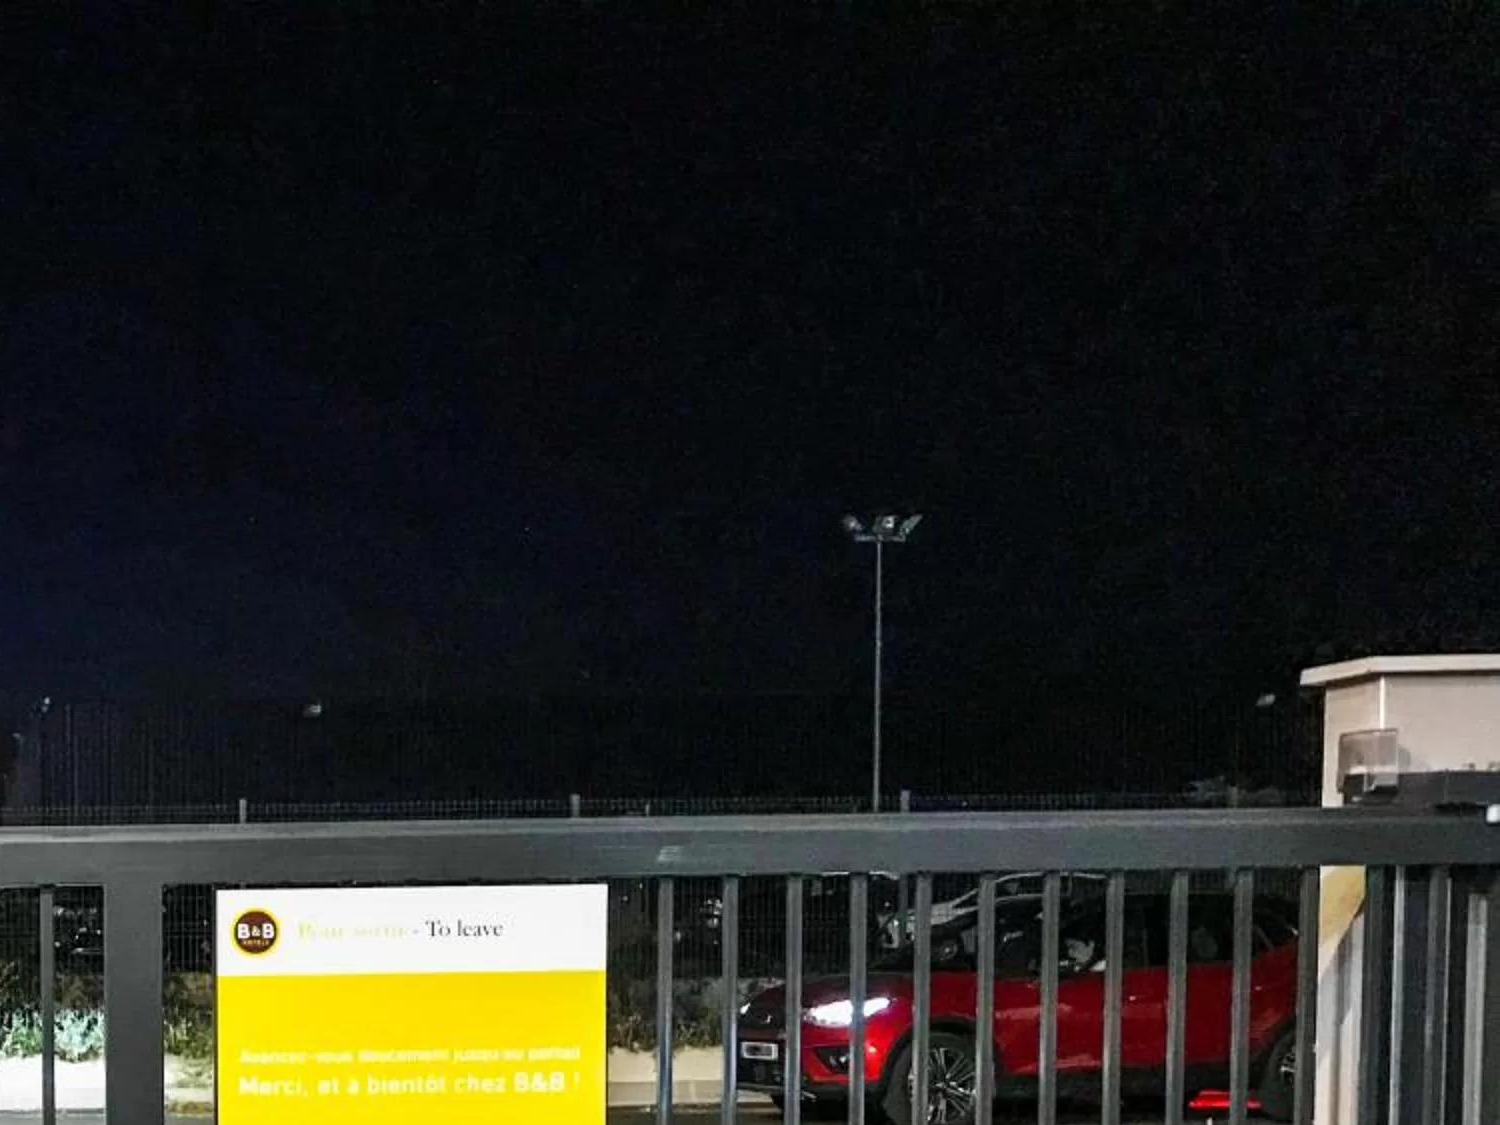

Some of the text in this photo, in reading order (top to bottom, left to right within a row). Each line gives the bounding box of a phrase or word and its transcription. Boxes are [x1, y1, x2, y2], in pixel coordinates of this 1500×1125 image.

[237, 923, 275, 939] B&B
[424, 919, 451, 937] To
[457, 918, 504, 937] leave
[239, 1075, 309, 1097] Merci,
[317, 1078, 341, 1095] et
[454, 1072, 506, 1093] chez
[514, 1070, 565, 1093] B&B
